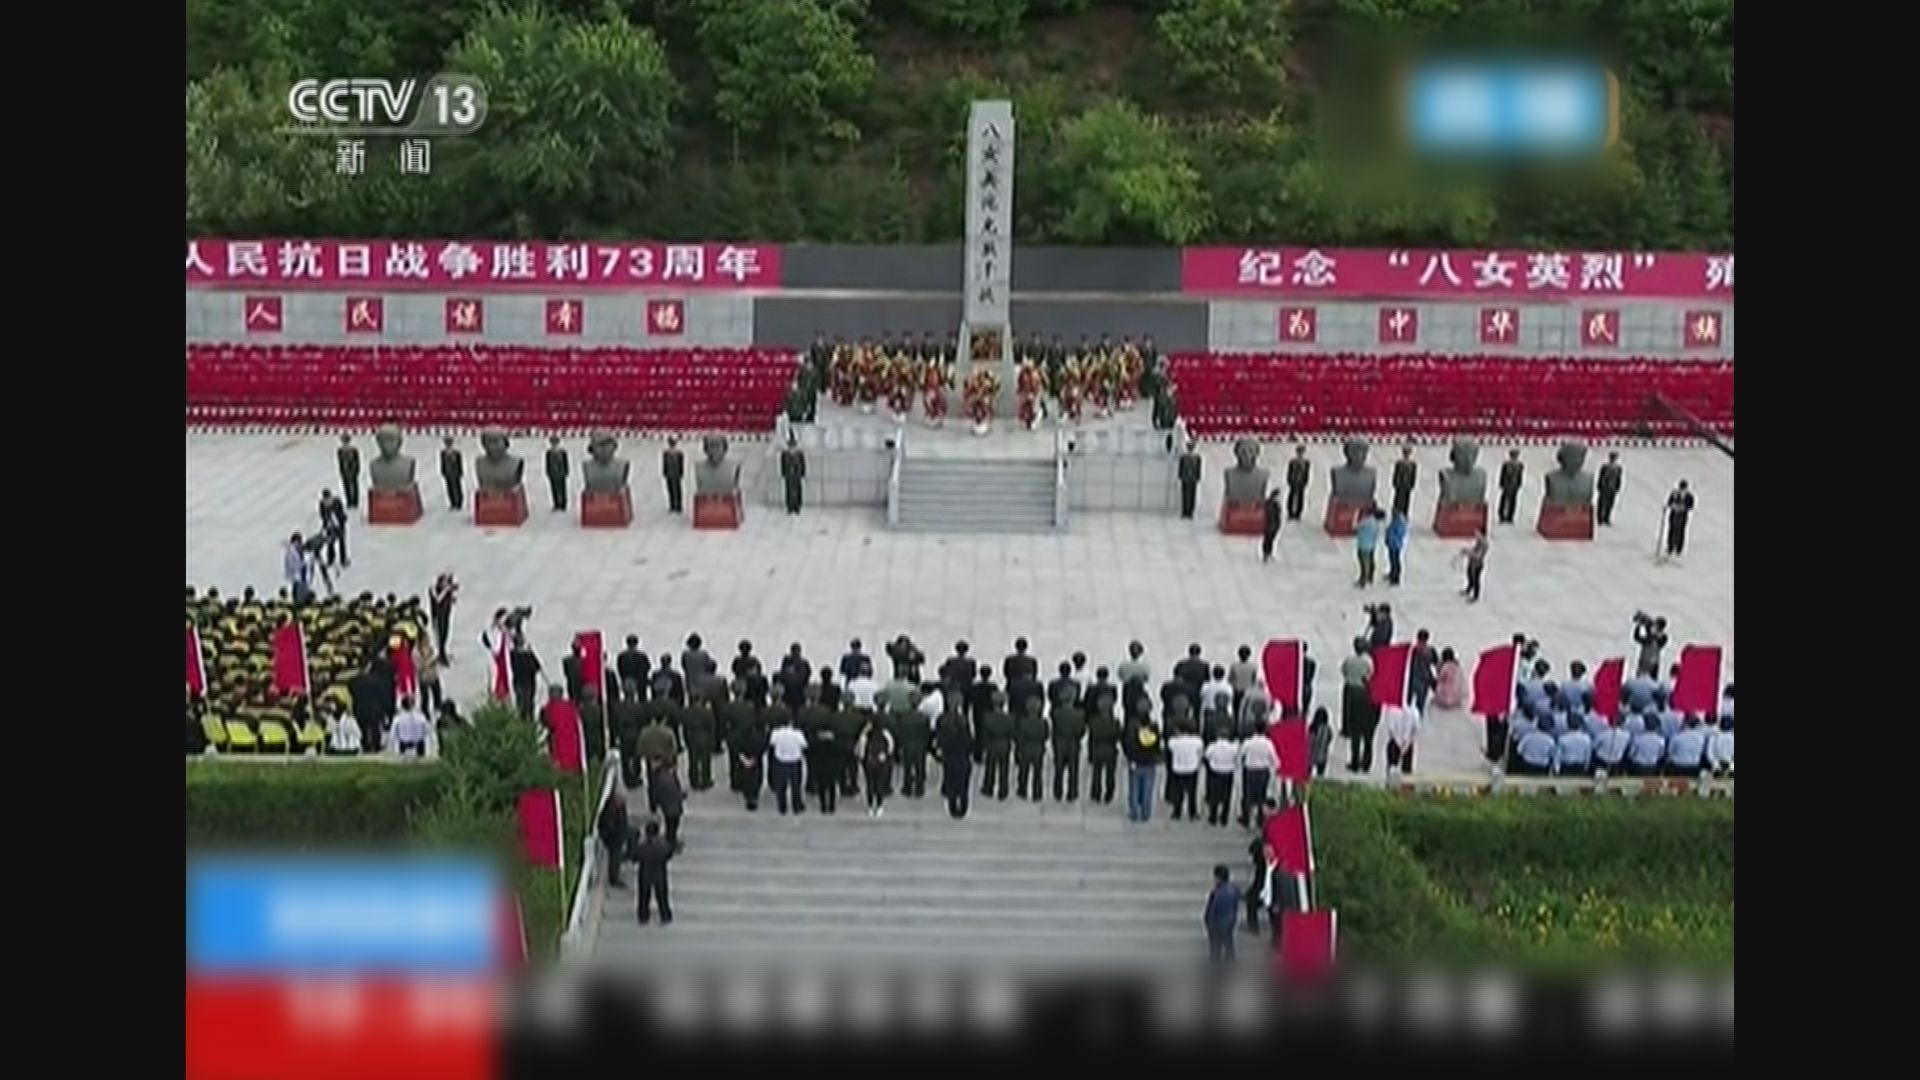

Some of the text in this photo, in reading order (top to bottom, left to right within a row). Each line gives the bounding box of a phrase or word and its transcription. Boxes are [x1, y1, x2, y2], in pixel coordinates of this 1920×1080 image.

[186, 240, 761, 282] 人民抗日战争胜利73周年
